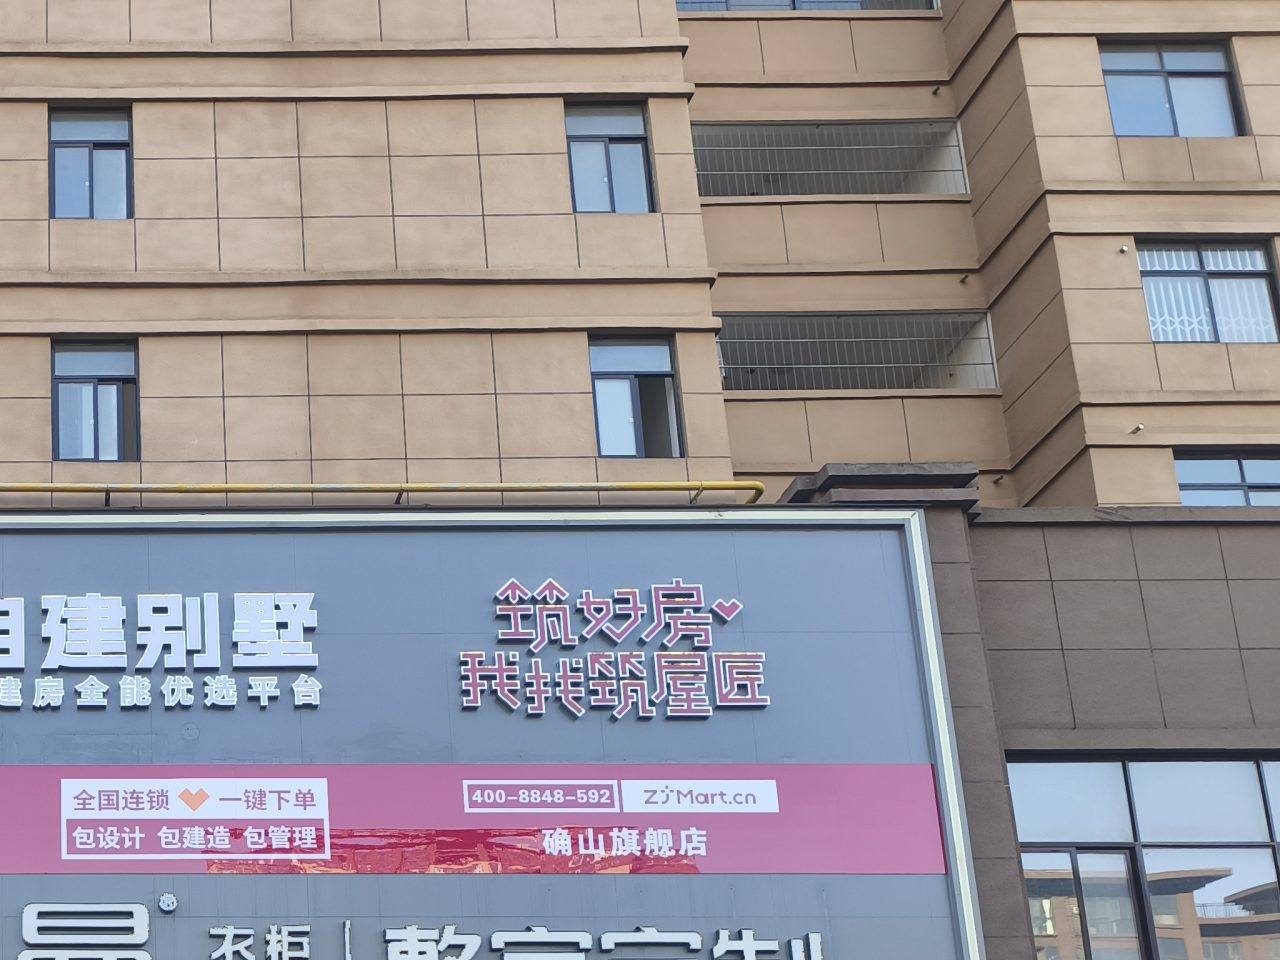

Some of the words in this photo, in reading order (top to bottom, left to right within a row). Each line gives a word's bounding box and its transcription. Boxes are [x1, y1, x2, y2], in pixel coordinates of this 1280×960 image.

[496, 578, 713, 653] 筑好房
[72, 788, 170, 812] 全国连锁
[218, 788, 317, 812] 一键下单
[472, 788, 612, 804] 400-8848-592
[72, 825, 146, 850] 包设计
[157, 825, 232, 850] 包建造
[242, 825, 318, 850] 包管理
[541, 826, 708, 858] 确山旗舰店
